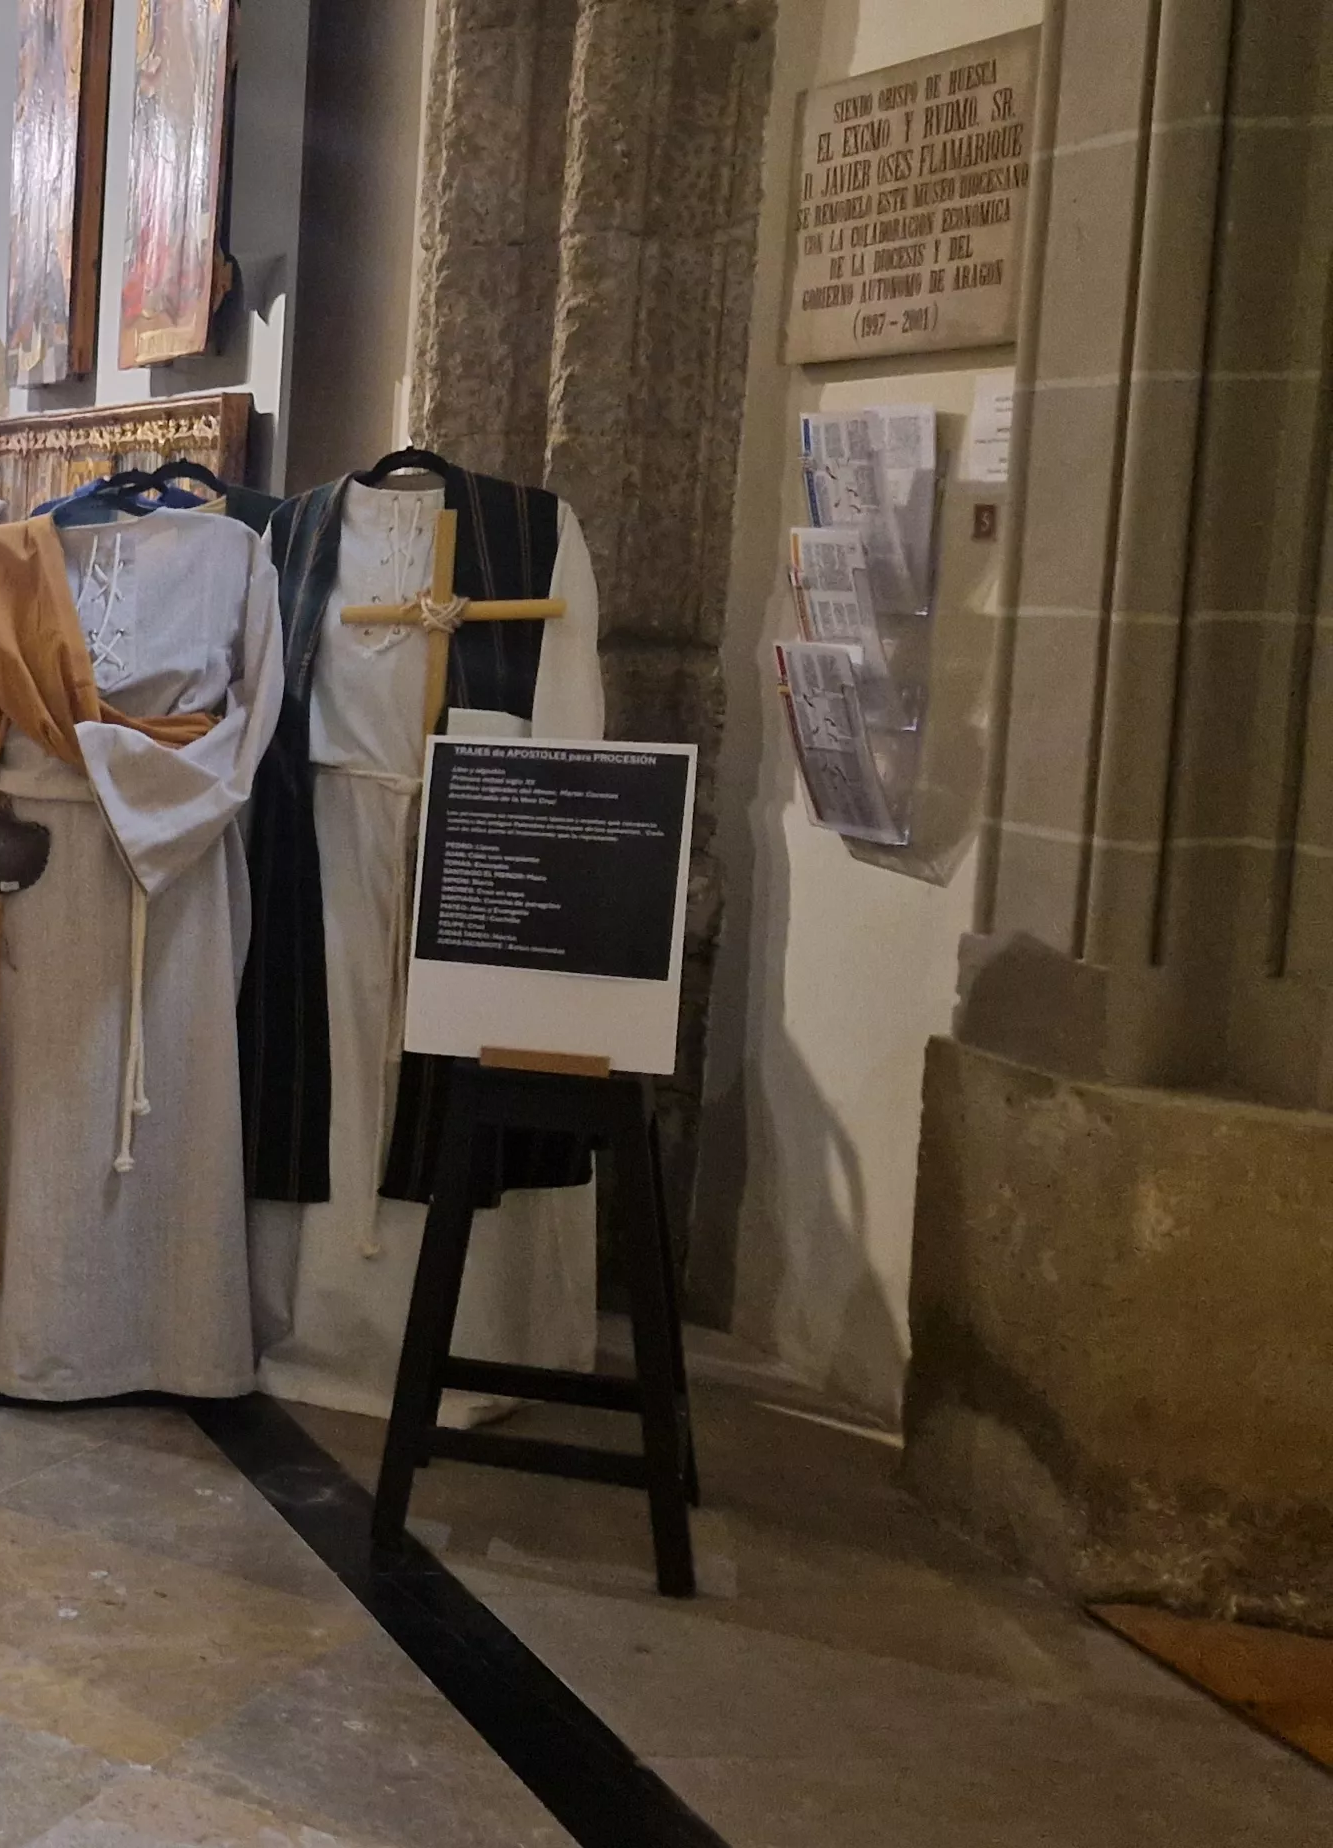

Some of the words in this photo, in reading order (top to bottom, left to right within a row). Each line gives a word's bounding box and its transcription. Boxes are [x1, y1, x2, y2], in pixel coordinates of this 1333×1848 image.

[834, 93, 873, 124] SIENDO
[878, 80, 918, 112] OBISPO
[925, 74, 942, 101] DE
[948, 58, 997, 96] HUESCA
[817, 132, 834, 164] EL
[904, 110, 914, 144] Y
[821, 159, 872, 198] JAVIER
[877, 149, 913, 186] OSES
[918, 122, 1024, 178] FLAMARIQUE
[796, 207, 810, 230] SE
[876, 186, 909, 216] ESTE
[913, 177, 955, 208] MUSEO
[959, 162, 1029, 200] DIOCESANO
[804, 234, 823, 256] CON
[830, 228, 844, 252] LA
[850, 211, 933, 248] COLABORACION
[941, 197, 1011, 234] ECONOMICA
[802, 283, 854, 312] GOBIERNO
[860, 272, 922, 303] AUTONOMO
[928, 268, 945, 294] DE
[952, 258, 1004, 292] ARAGON
[829, 256, 845, 281] DE
[851, 252, 865, 277] LA
[873, 242, 925, 273] DIOCESIS
[934, 238, 942, 264] Y
[948, 234, 973, 262] DEL
[454, 745, 491, 757] TRAJES
[492, 748, 505, 758] de
[568, 752, 592, 764] para
